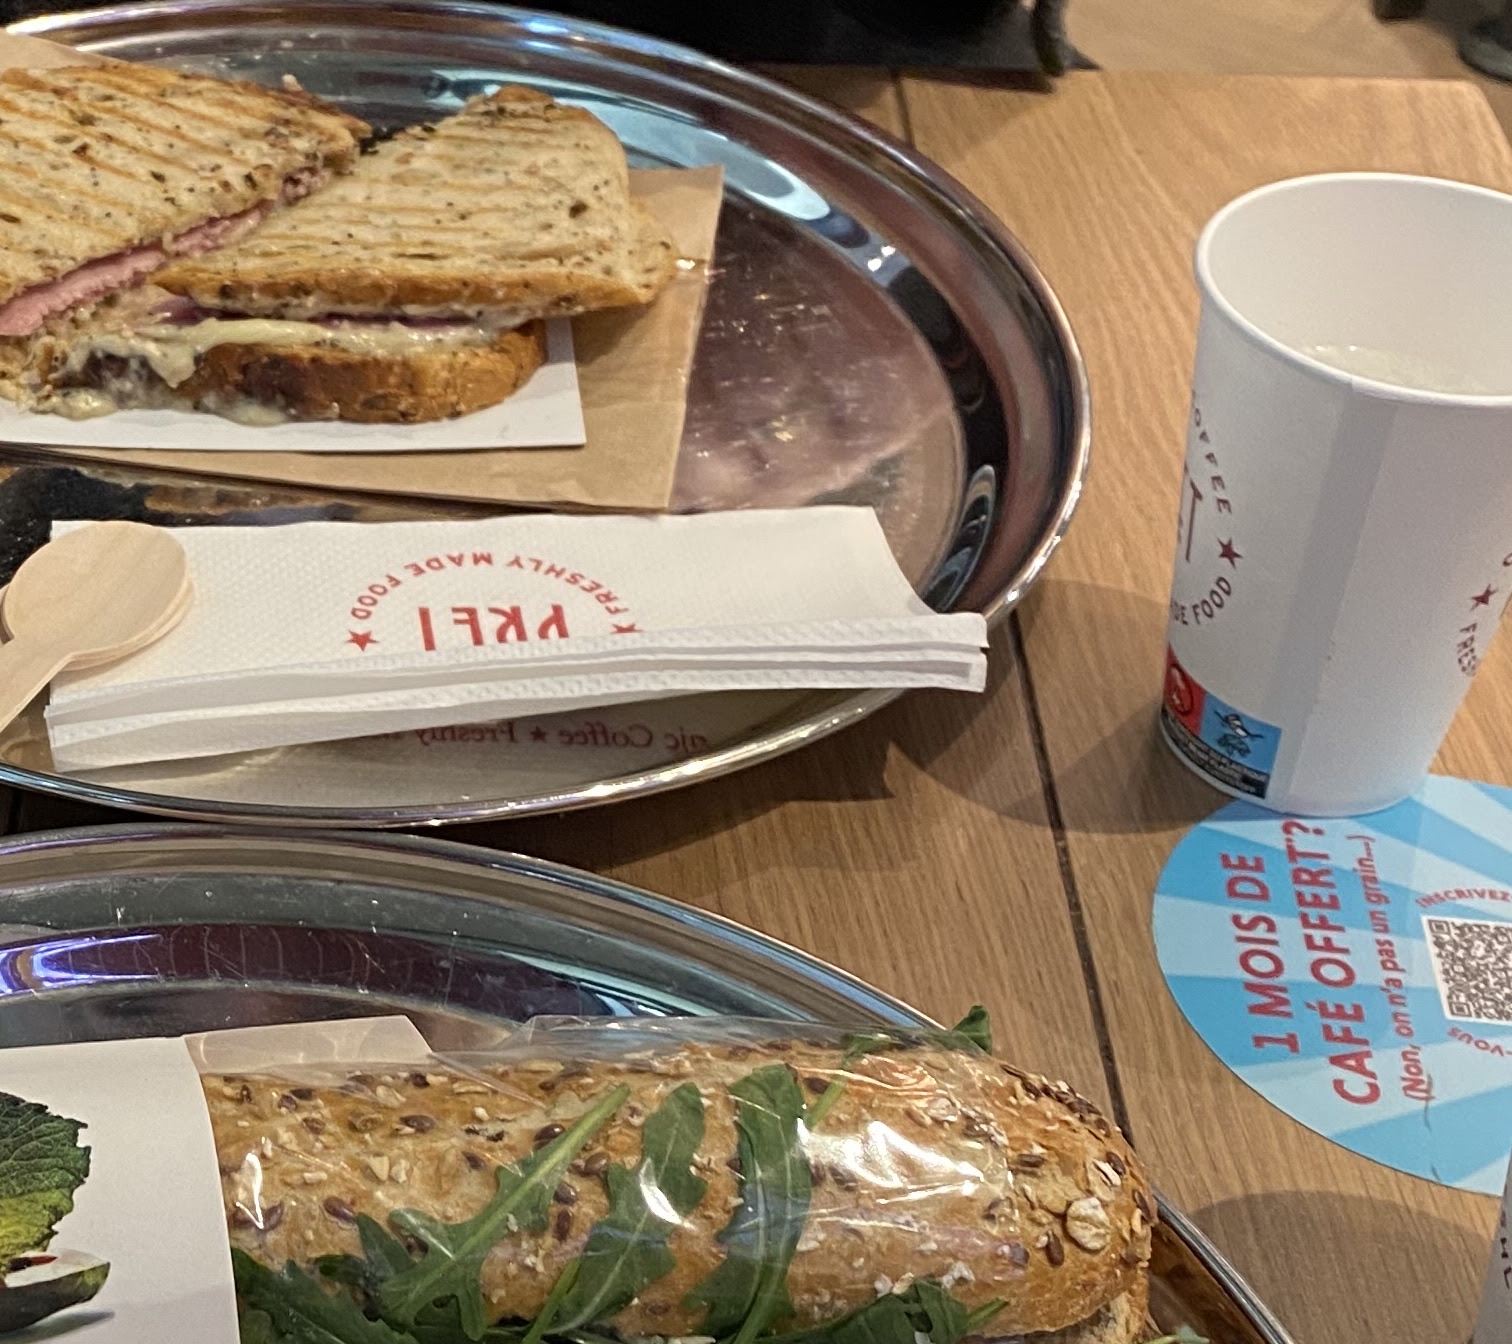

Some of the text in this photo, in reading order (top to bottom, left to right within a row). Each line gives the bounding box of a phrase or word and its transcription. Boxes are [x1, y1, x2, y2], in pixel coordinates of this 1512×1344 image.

[1191, 391, 1233, 514] OFFEE
[350, 552, 630, 620] FRESHLY MADE FOOD
[1192, 576, 1233, 625] FOOD
[1369, 910, 1389, 932] un
[1220, 853, 1300, 1054] 1 MOIS DE
[1375, 938, 1406, 973] pas
[1380, 977, 1407, 1007] n'a
[1392, 1010, 1414, 1038] on
[1305, 1000, 1381, 1105] CAFÉ
